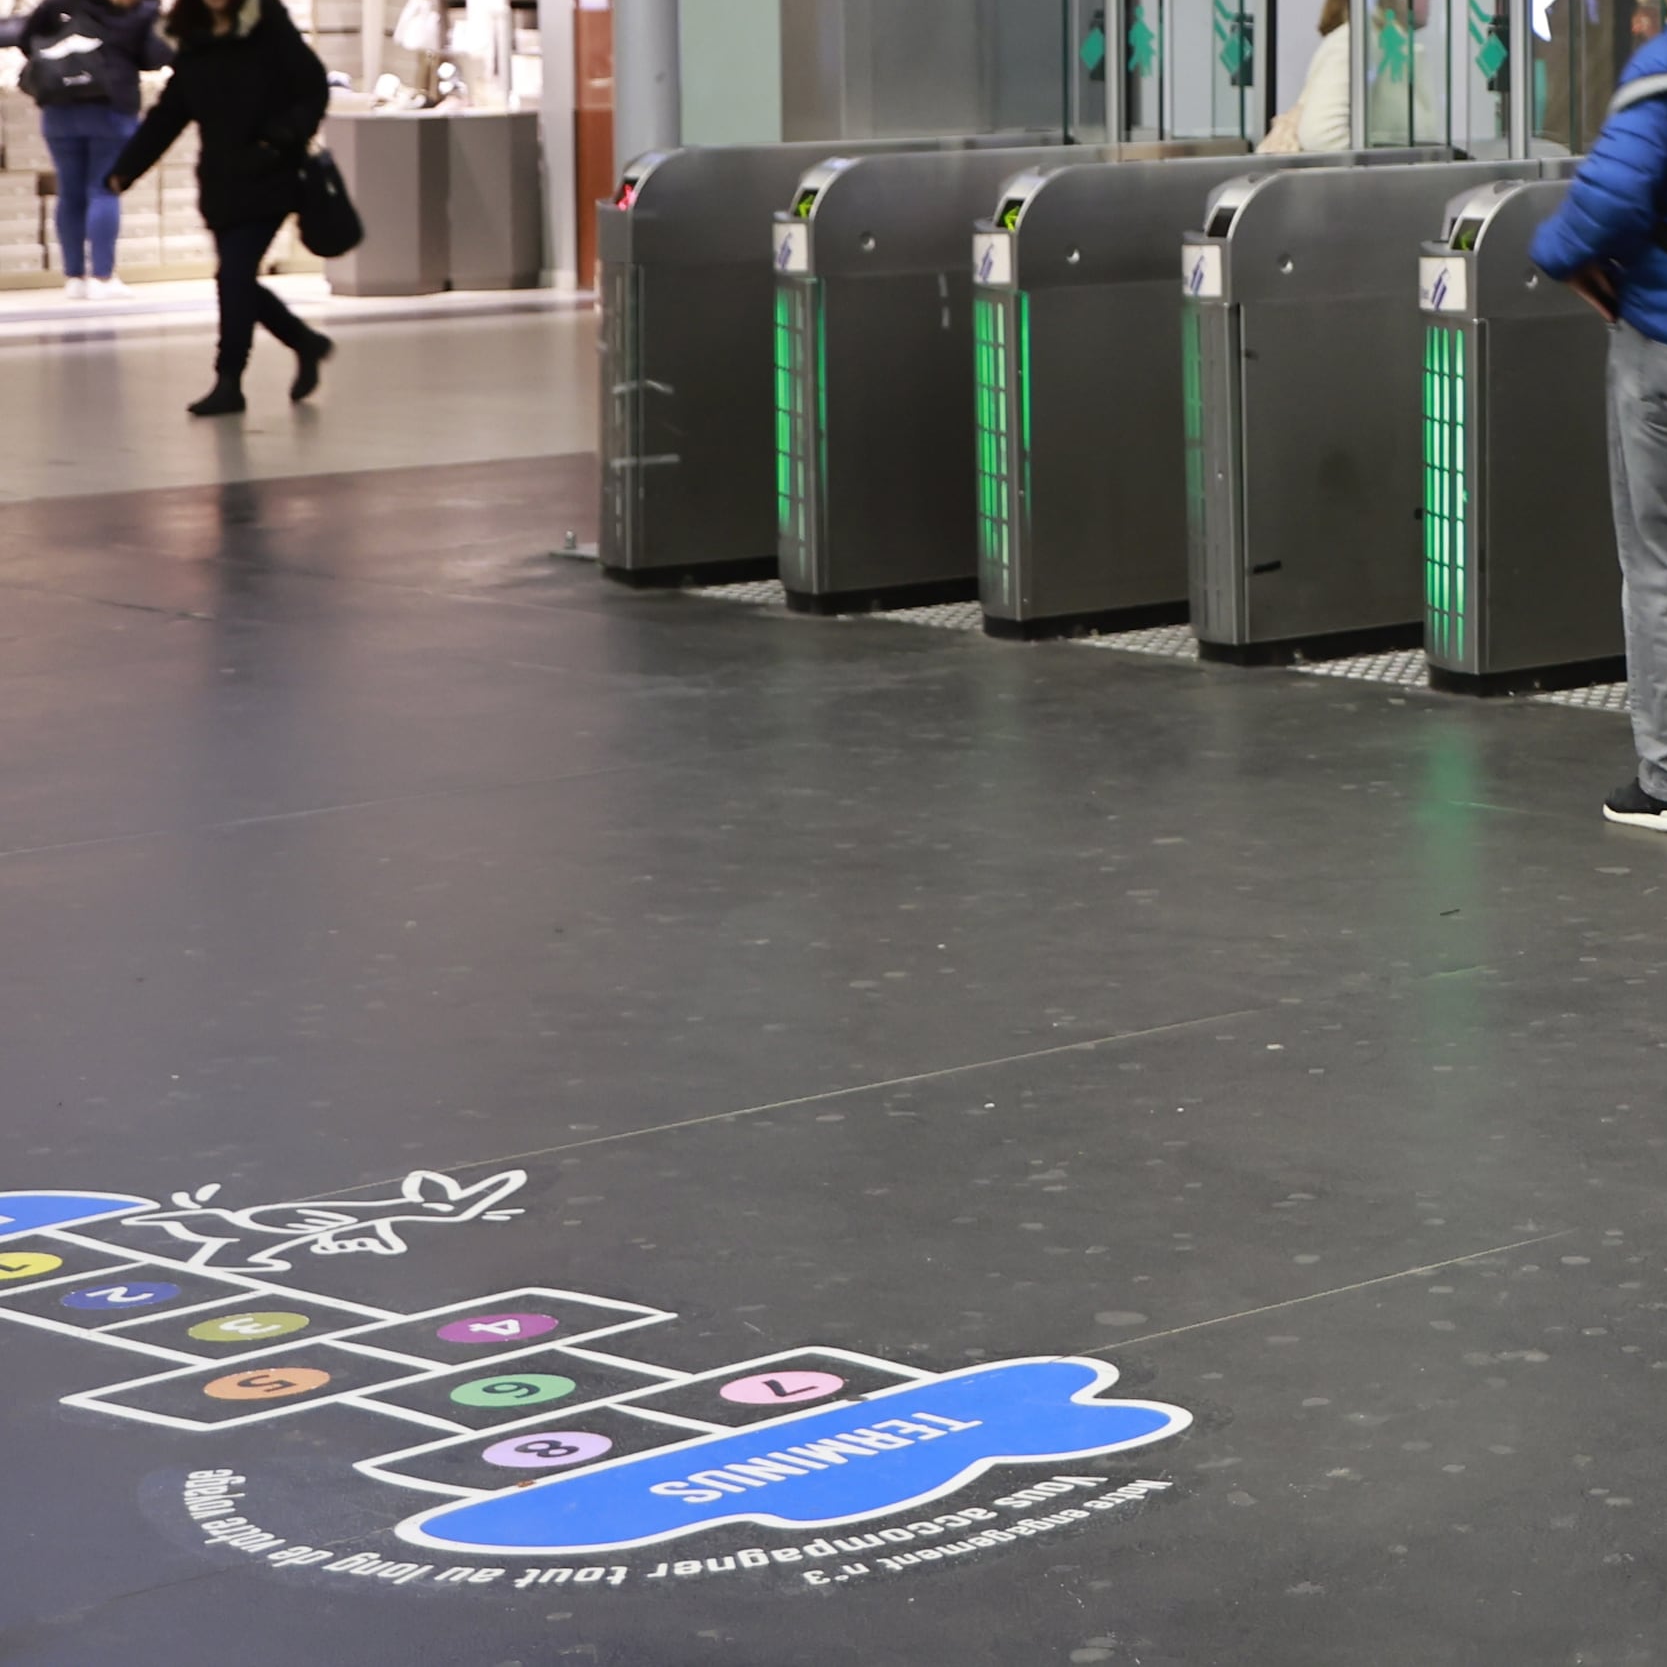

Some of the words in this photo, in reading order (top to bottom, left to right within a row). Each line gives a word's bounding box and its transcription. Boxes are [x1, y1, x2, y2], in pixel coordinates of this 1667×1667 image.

[85, 1285, 155, 1303] 2
[218, 1316, 282, 1337] 3
[468, 1317, 521, 1337] 4
[236, 1373, 297, 1394] 5
[482, 1380, 542, 1399] 6
[761, 1378, 819, 1398] 7
[513, 1438, 580, 1459] 8
[649, 1411, 984, 1504] TERMINUS
[183, 1467, 247, 1521] voyage
[993, 1475, 1109, 1509] Vous
[1083, 1479, 1174, 1510] Notre
[200, 1516, 287, 1554] votre
[646, 1506, 999, 1579] accompagner
[876, 1507, 1091, 1571] engagement
[266, 1545, 335, 1568] de
[321, 1551, 435, 1585] long
[434, 1565, 506, 1583] au
[513, 1565, 629, 1588] tout
